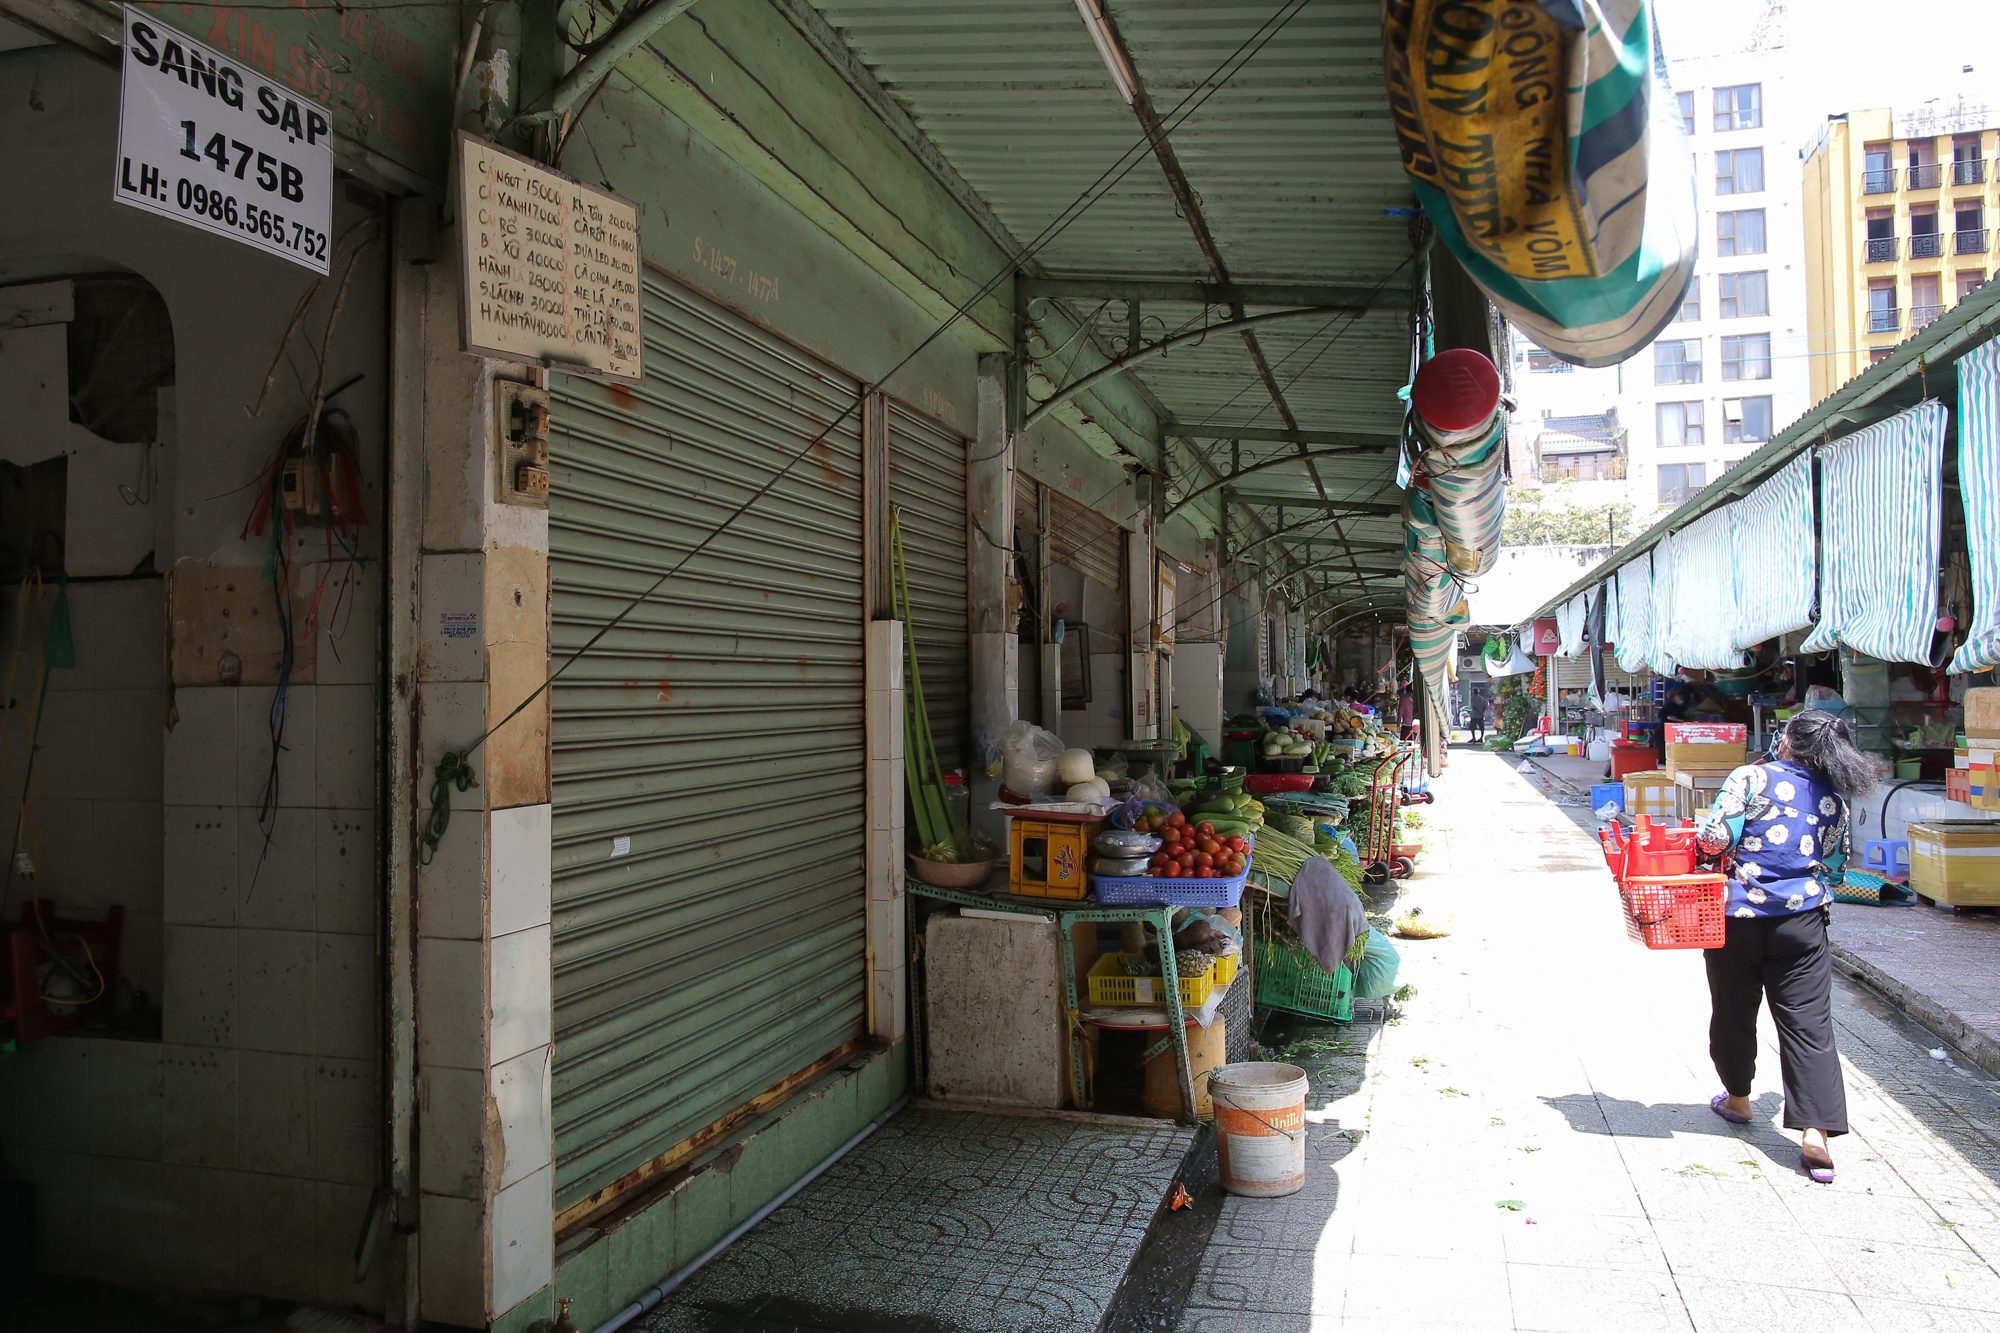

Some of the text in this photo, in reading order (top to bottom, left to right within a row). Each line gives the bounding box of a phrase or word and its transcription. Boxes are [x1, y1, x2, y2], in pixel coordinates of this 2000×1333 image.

[131, 21, 328, 146] SANG SẠP
[180, 120, 304, 203] 1475B
[1524, 137, 1561, 206] NHÀ
[121, 157, 327, 262] LH: 0986.565.752
[1524, 219, 1573, 273] VÒM
